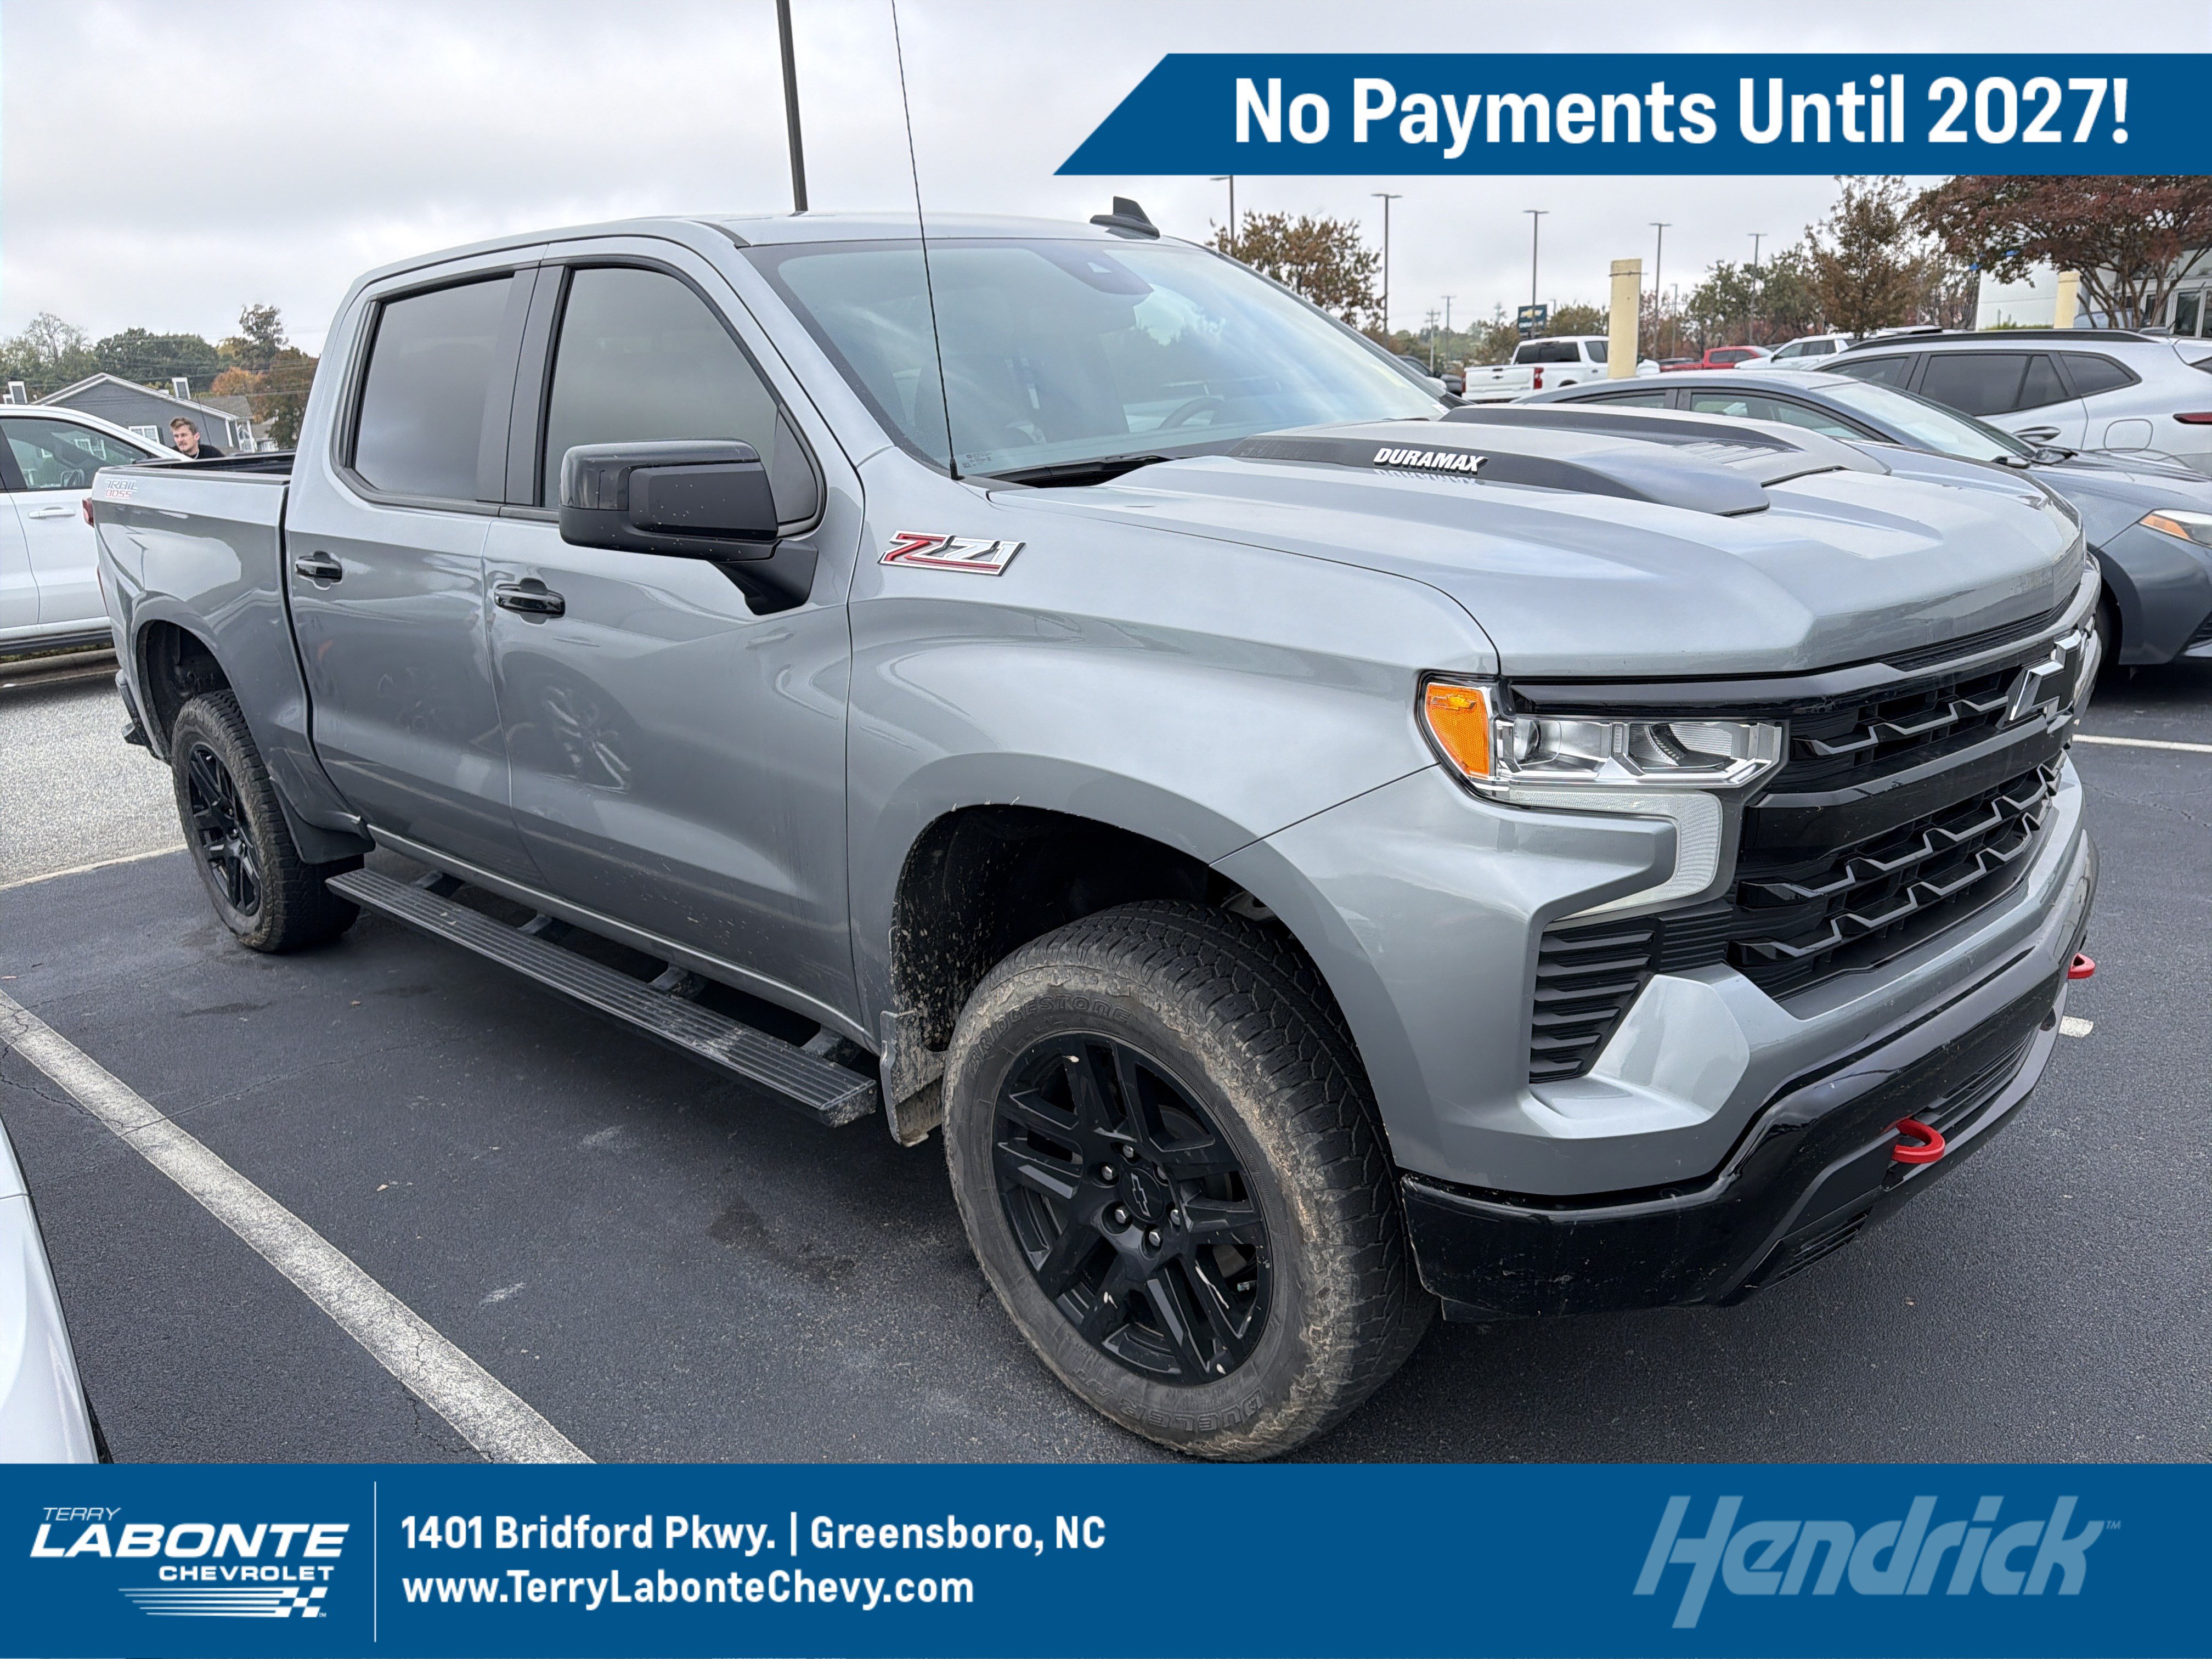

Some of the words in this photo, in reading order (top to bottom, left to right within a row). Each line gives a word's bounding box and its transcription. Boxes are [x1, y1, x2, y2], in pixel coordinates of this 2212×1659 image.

[1373, 447, 1488, 475] DURAMAX
[105, 490, 132, 498] BOSS
[106, 479, 138, 490] TRAIL
[878, 530, 1026, 577] Z71
[967, 994, 1131, 1079] BRIDGESTONE
[1119, 1387, 1263, 1432] DUELER
